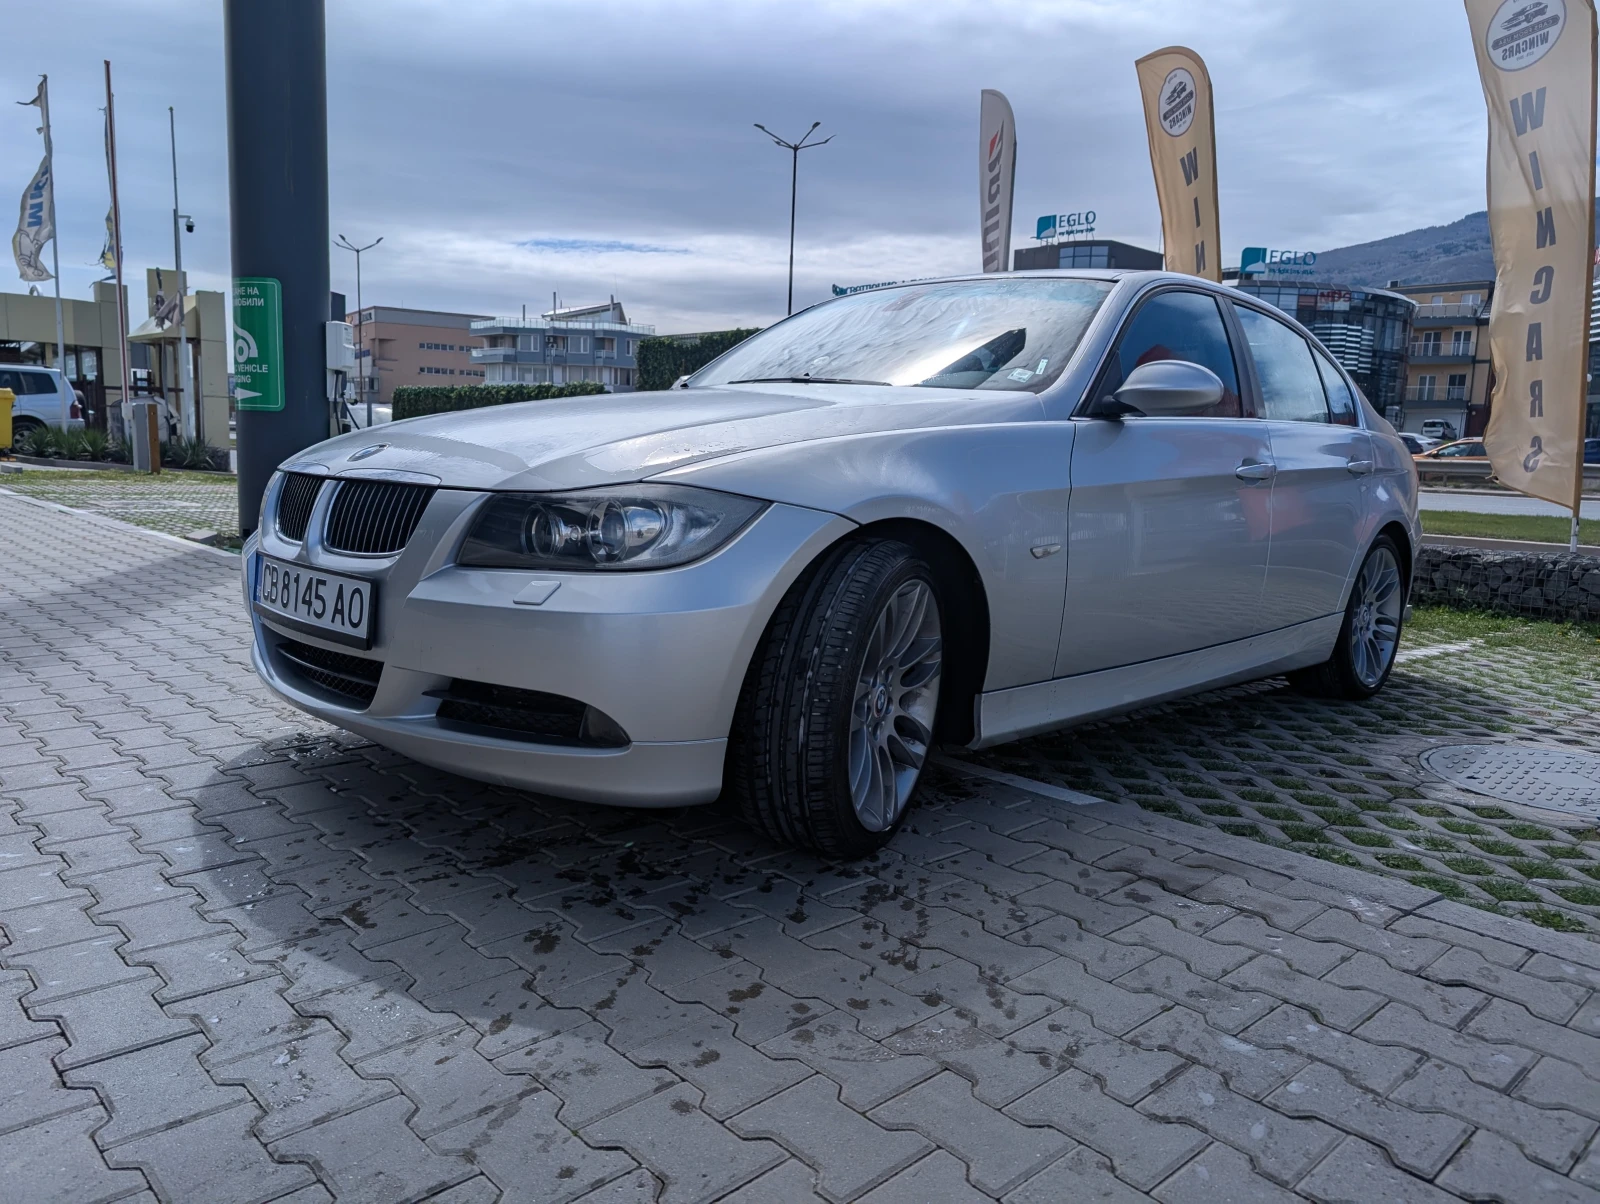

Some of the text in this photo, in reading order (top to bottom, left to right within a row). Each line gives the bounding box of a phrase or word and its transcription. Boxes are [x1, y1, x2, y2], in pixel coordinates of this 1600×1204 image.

[1058, 211, 1097, 228] EGLO
[1270, 250, 1317, 266] EGLO
[247, 286, 260, 295] НА
[238, 364, 269, 373] VEHICLE
